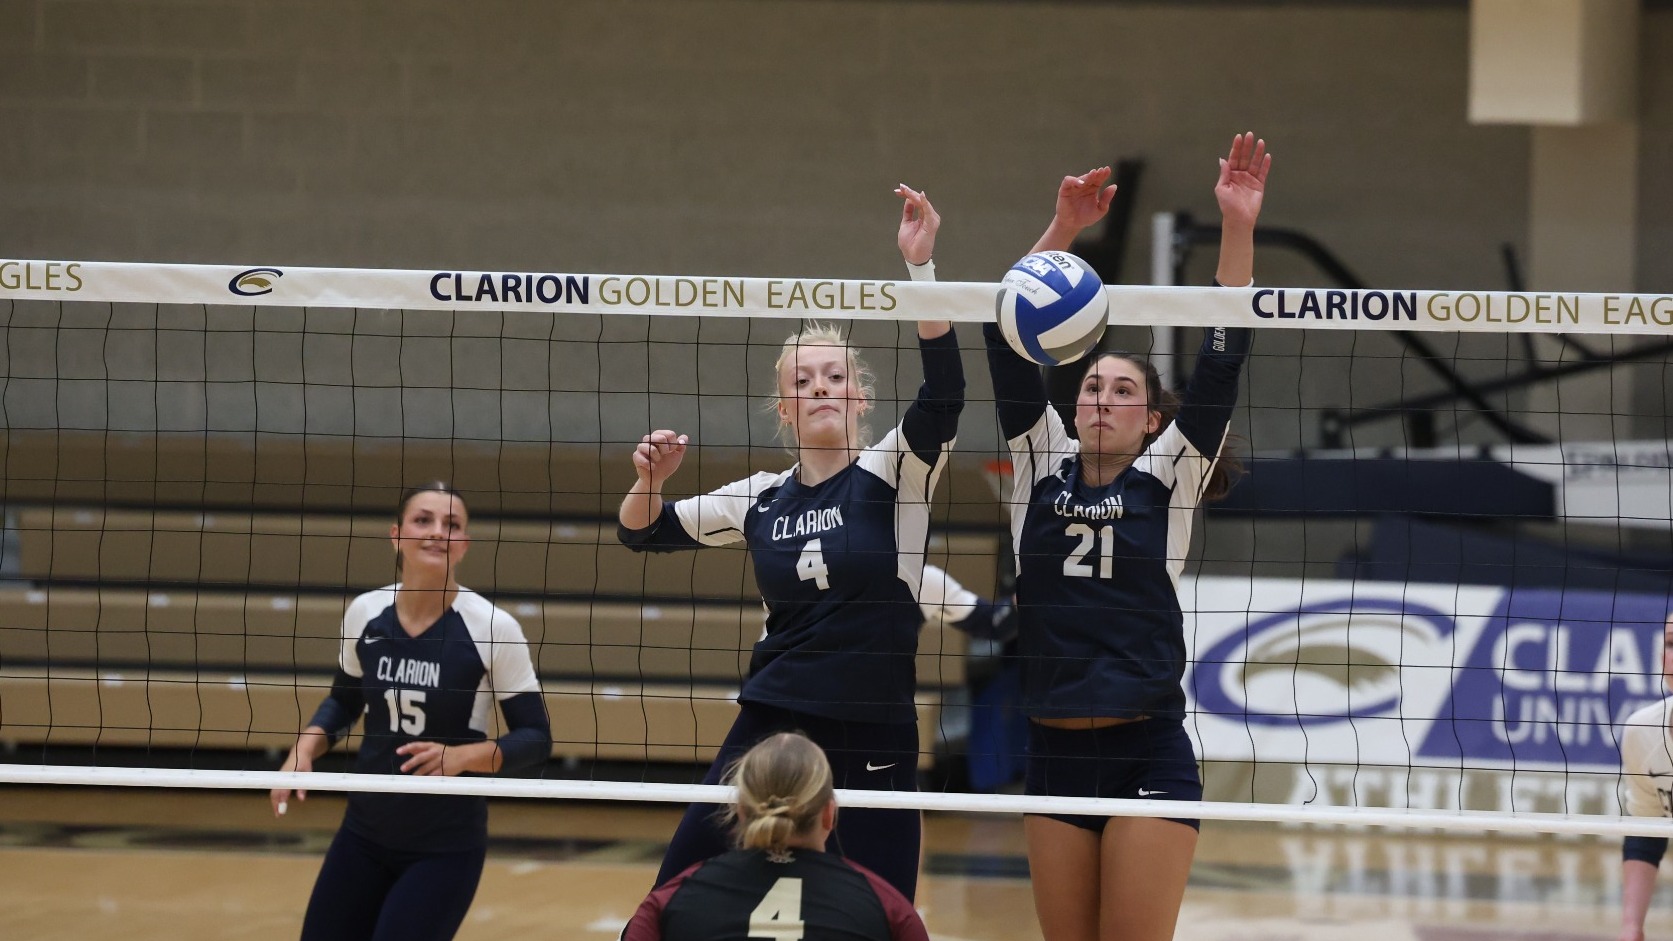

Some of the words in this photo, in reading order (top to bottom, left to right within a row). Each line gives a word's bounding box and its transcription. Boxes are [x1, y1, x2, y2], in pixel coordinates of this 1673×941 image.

[430, 271, 589, 305] CLARION
[598, 276, 744, 308] GOLDEN
[767, 280, 897, 312] EAGLES
[1252, 289, 1417, 321] CLARION
[1426, 292, 1580, 324] GOLDEN
[771, 504, 844, 541] CLARION
[1054, 490, 1124, 520] CLARION
[796, 537, 831, 591] 4
[1063, 523, 1114, 579] 21
[376, 655, 441, 688] CLARION
[383, 687, 427, 737] 15
[747, 876, 805, 941] 4
